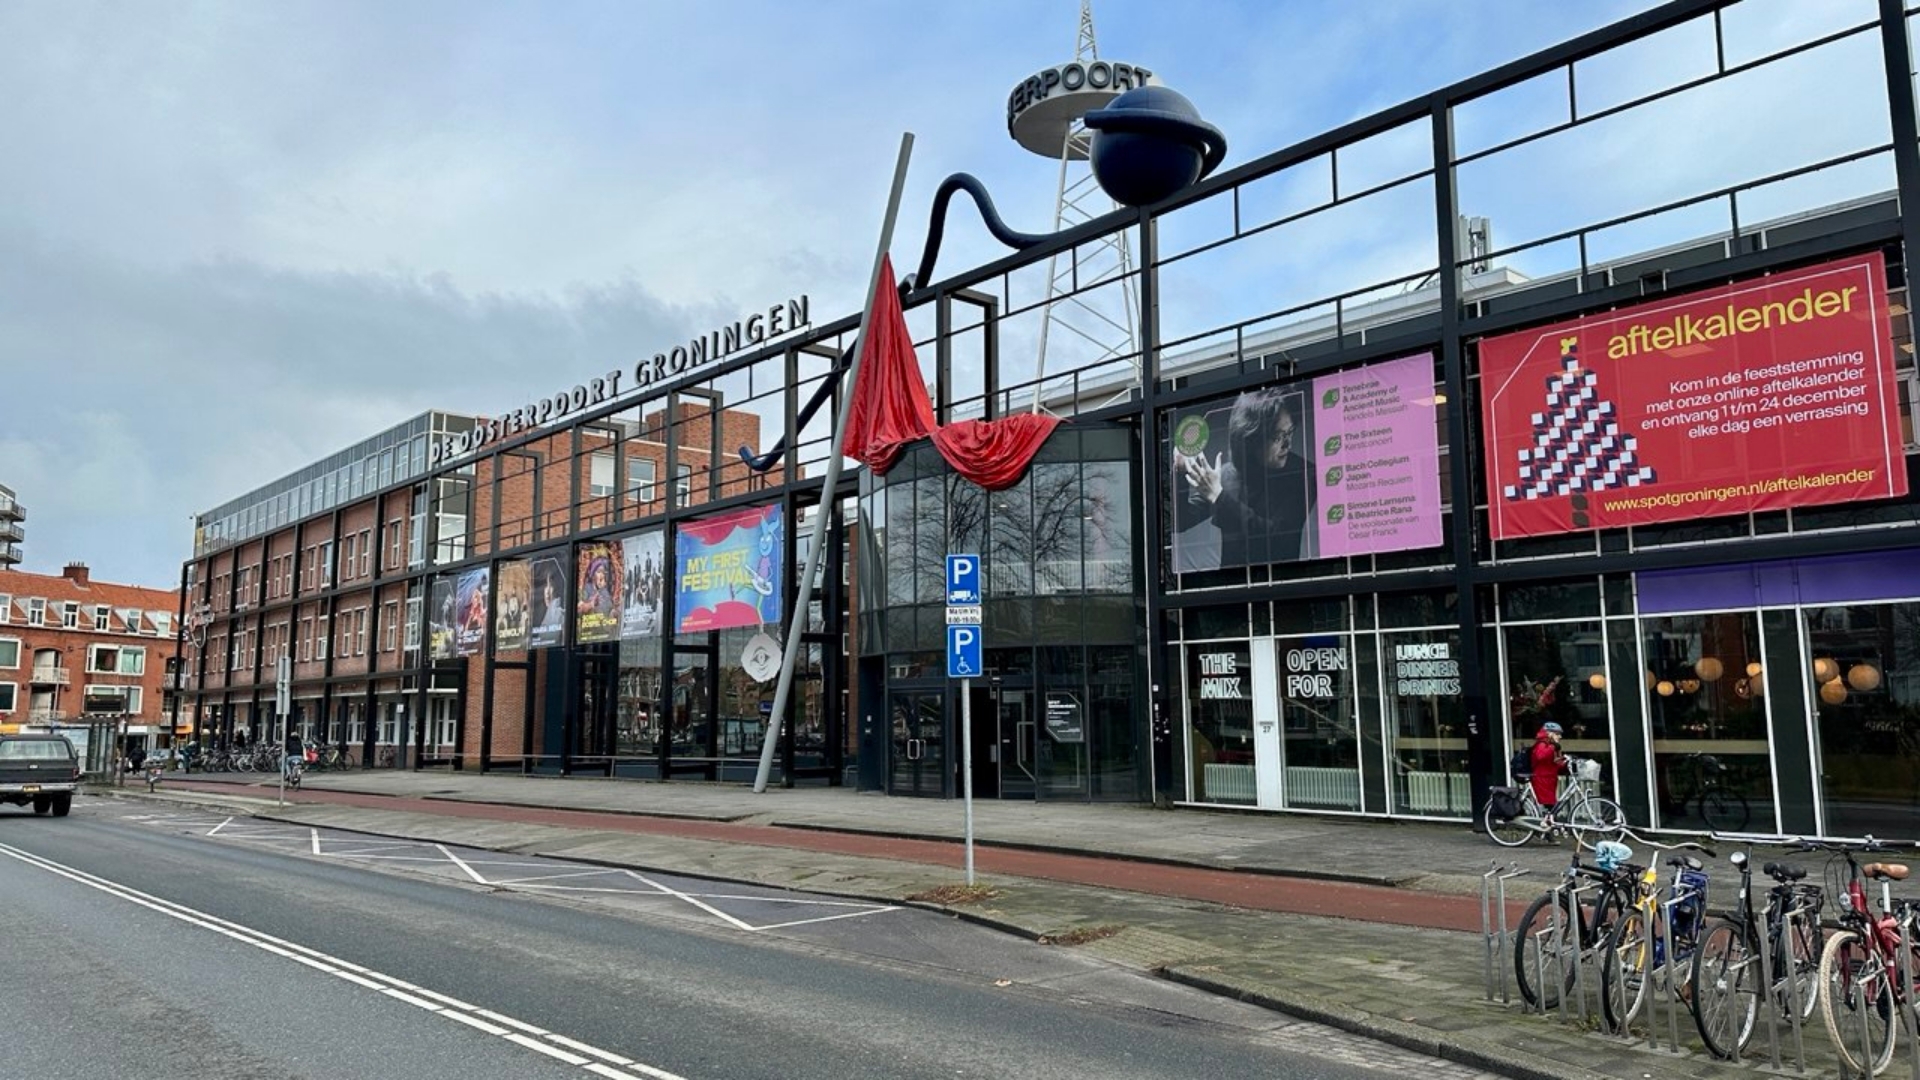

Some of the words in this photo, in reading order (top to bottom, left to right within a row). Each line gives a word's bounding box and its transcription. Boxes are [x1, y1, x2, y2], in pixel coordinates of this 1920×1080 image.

[1607, 286, 1858, 360] aftelkalender
[431, 436, 452, 464] DE
[460, 370, 621, 449] OOSTERPOORT
[634, 294, 809, 386] GRONINGEN
[1670, 379, 1702, 394] Kom
[1706, 375, 1719, 388] in
[1721, 371, 1742, 386] de
[1744, 351, 1864, 382] feeststemming
[1342, 381, 1380, 393] Tenebrae
[1350, 388, 1387, 401] Academy
[1389, 385, 1398, 394] of
[1646, 399, 1674, 414] met
[1676, 394, 1711, 409] onze
[1714, 384, 1759, 404] online
[1762, 367, 1865, 394] aftelkalender
[1343, 399, 1374, 412] Ancient
[1375, 396, 1400, 407] Music
[1641, 418, 1659, 430] en
[1661, 407, 1718, 427] ontvang
[1730, 400, 1757, 415] t/m
[1759, 397, 1780, 412] 24
[1782, 383, 1868, 408] december
[1688, 425, 1718, 439] elke
[1721, 419, 1750, 434] dag
[1752, 415, 1782, 429] een
[1784, 401, 1868, 424] verrassing
[1344, 433, 1359, 441] The
[1360, 427, 1392, 438] Sixteen
[1345, 462, 1366, 471] Bach
[1367, 456, 1409, 469] Collegium
[1346, 472, 1371, 482] Japan
[1377, 475, 1413, 487] Requiem
[1604, 469, 1875, 512] www.spotgroningen.nl/aftelkalender
[1347, 500, 1377, 510] Simone
[1355, 508, 1389, 519] Beatrice
[1390, 506, 1412, 515] Rana
[1348, 521, 1358, 530] De
[686, 556, 708, 574] MY
[711, 548, 750, 569] FIRST
[954, 559, 973, 585] P
[681, 567, 753, 593] FESTIVAL
[955, 629, 974, 655] P
[1395, 643, 1450, 661] LUNCH
[1200, 652, 1237, 675] THE
[1286, 648, 1348, 672] OPEN
[1397, 660, 1459, 678] DINNER
[1200, 677, 1242, 699] MIX
[1286, 674, 1333, 698] FOR
[1397, 678, 1462, 696] DRINKS
